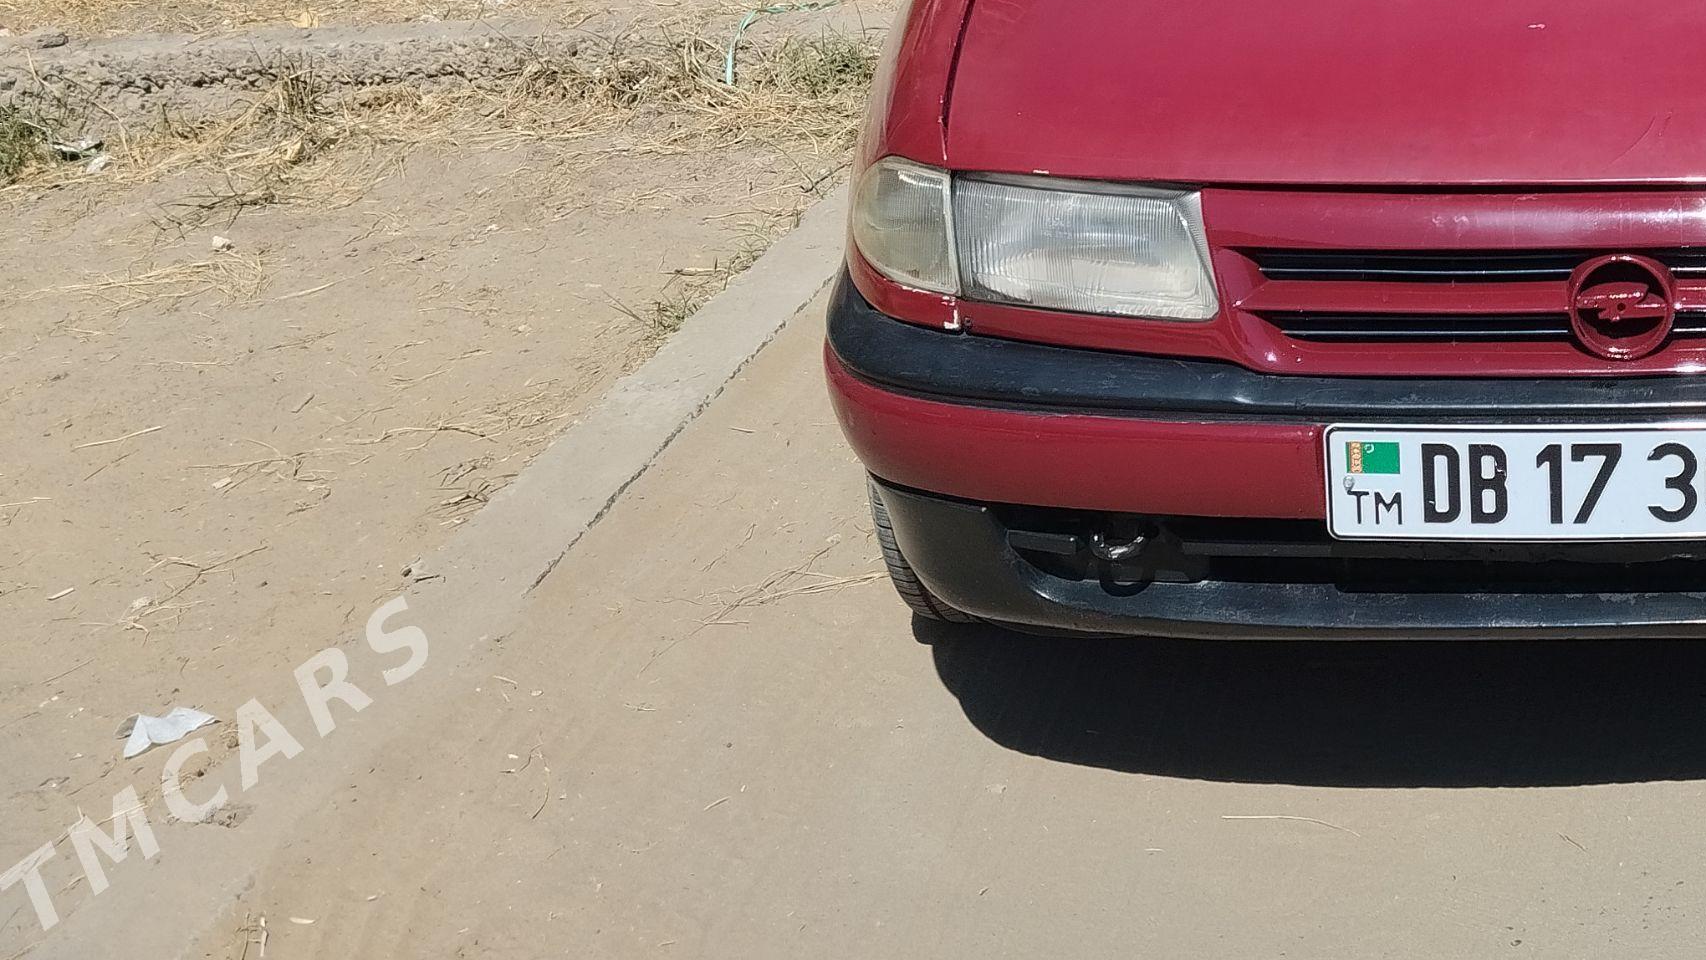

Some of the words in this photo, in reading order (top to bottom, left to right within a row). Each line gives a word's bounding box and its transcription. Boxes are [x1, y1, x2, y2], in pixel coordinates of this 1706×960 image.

[1347, 490, 1402, 525] TM
[1421, 443, 1508, 524] DB
[1536, 443, 1622, 524] 17
